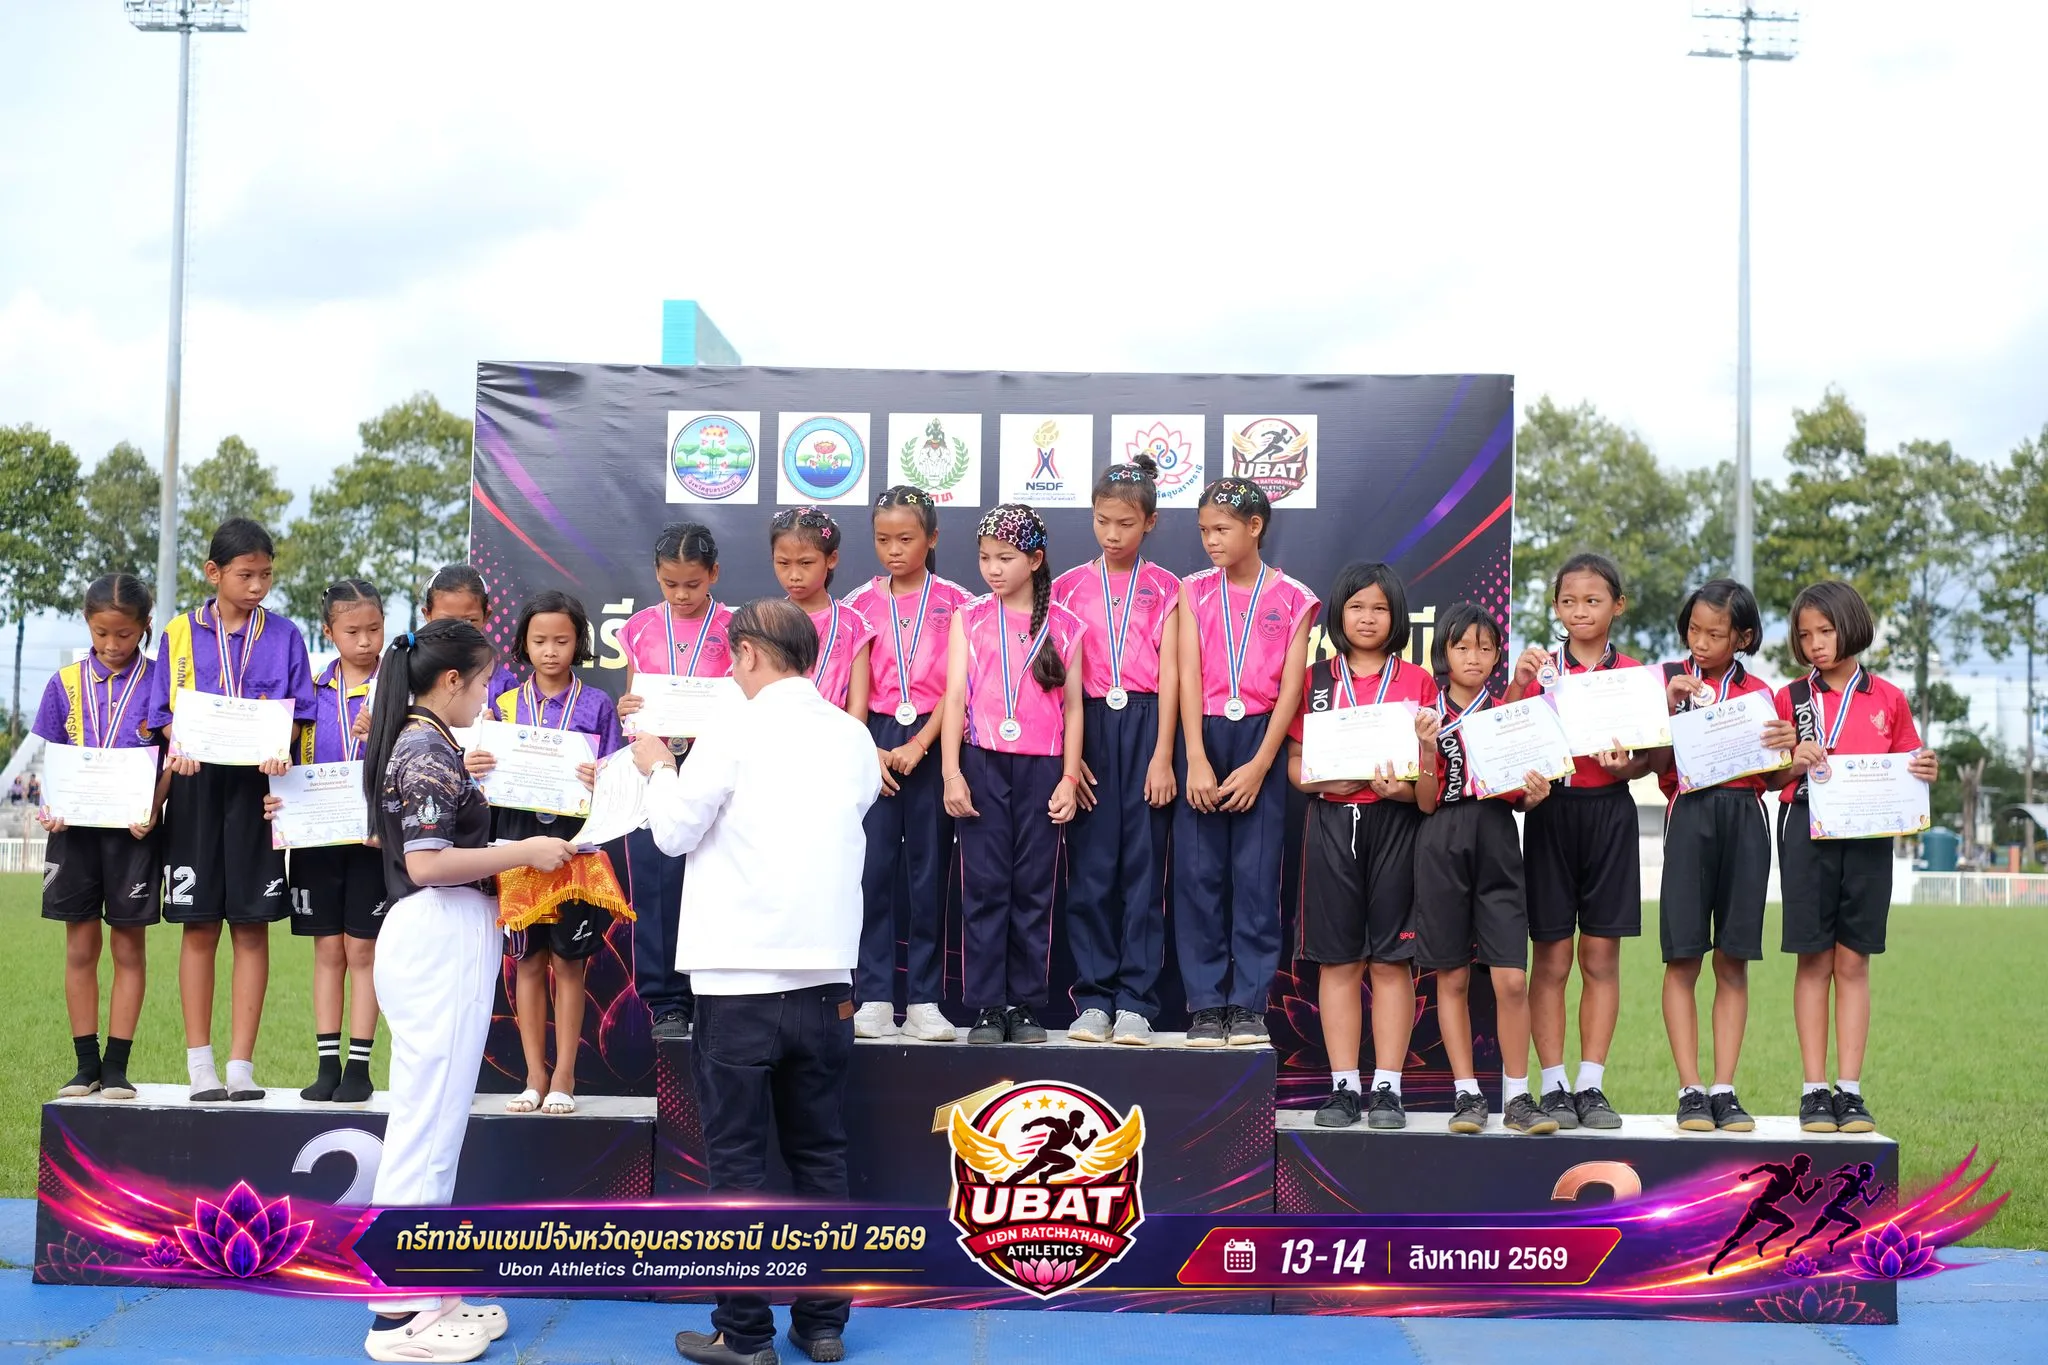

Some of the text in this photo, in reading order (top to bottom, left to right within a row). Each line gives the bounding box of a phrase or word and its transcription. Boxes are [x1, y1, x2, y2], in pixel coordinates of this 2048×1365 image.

[1239, 462, 1303, 479] UBAT
[1026, 482, 1064, 491] NSDF
[163, 864, 196, 906] 12
[290, 887, 313, 915] 11
